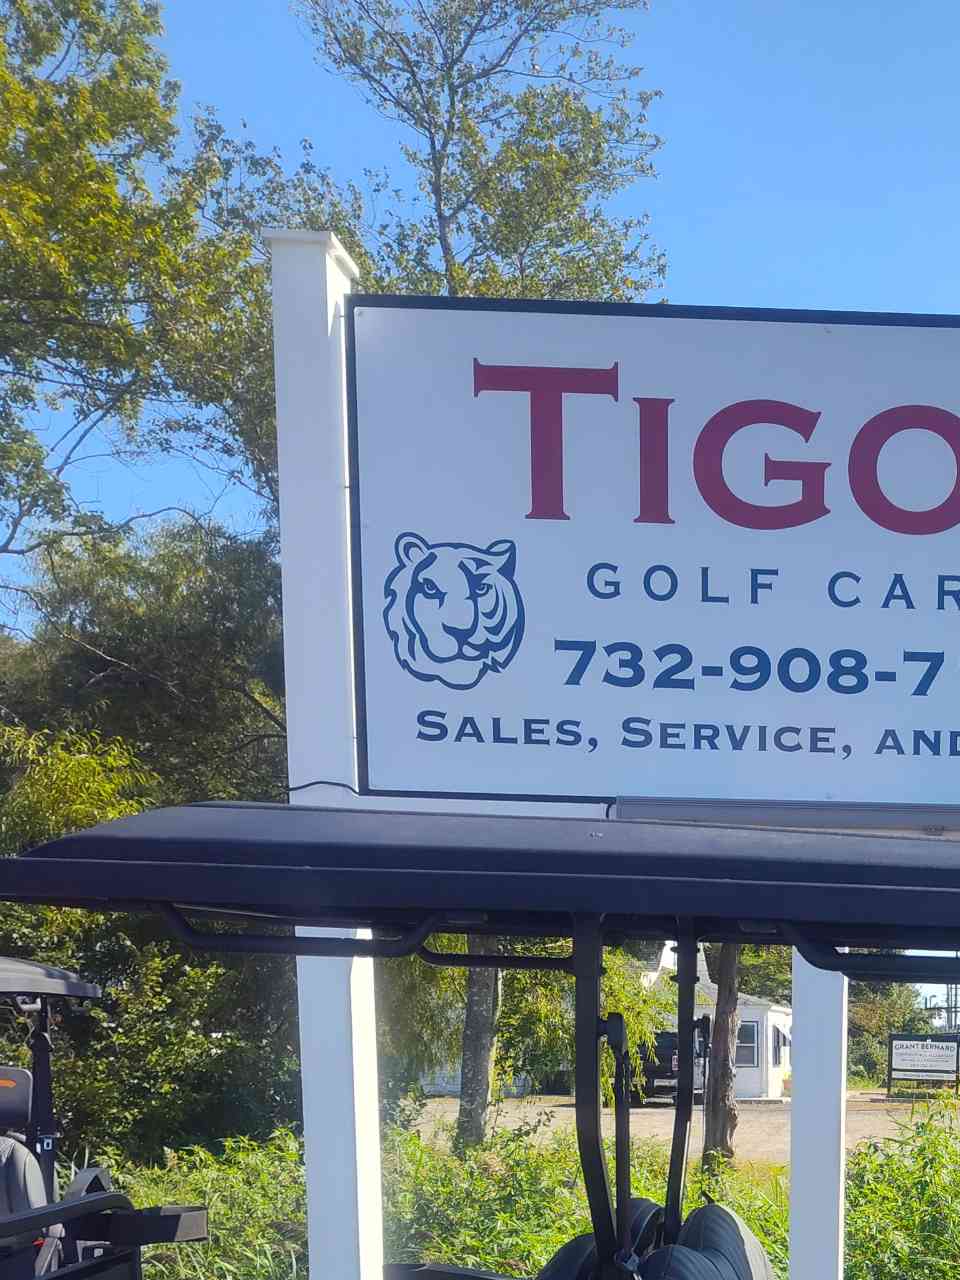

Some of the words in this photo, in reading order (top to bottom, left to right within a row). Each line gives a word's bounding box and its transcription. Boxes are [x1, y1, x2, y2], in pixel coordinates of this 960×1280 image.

[586, 562, 779, 605] GOLF
[416, 709, 599, 754] SALES,
[620, 716, 853, 760] SERVICE,
